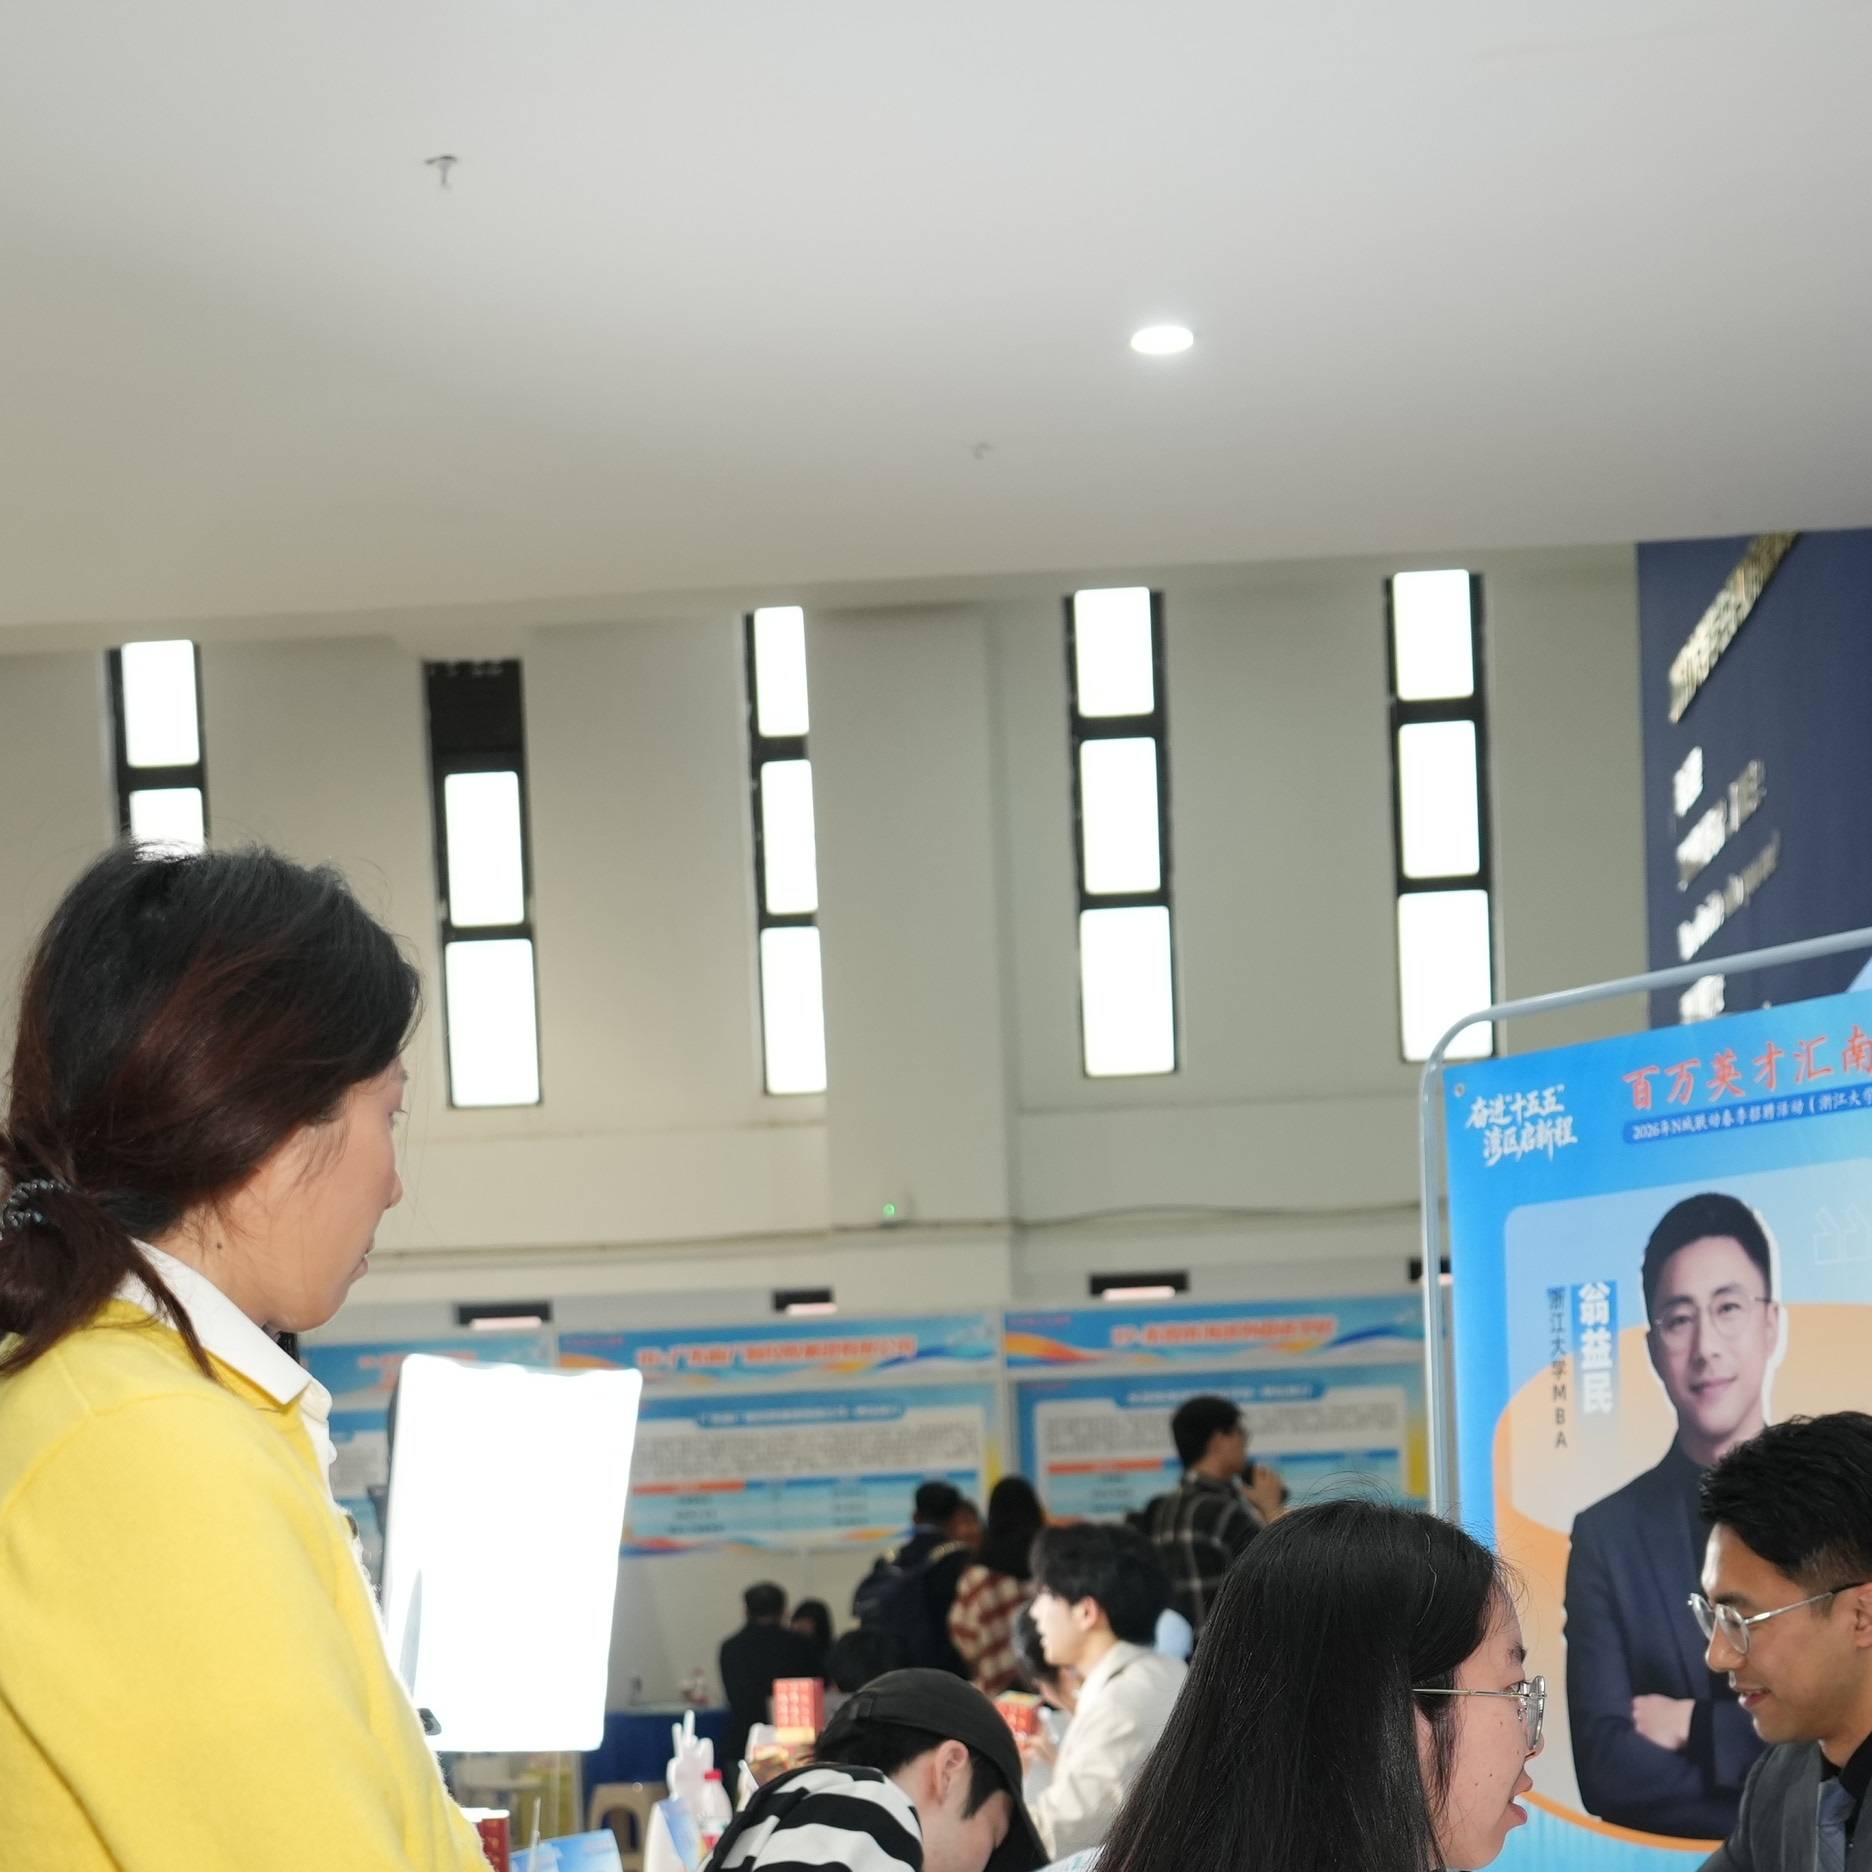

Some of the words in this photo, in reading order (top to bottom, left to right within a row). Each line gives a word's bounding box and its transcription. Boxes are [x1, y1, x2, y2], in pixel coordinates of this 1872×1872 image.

[1482, 1115, 1579, 1167] 湾区启新程
[1578, 1280, 1614, 1415] 翁益民
